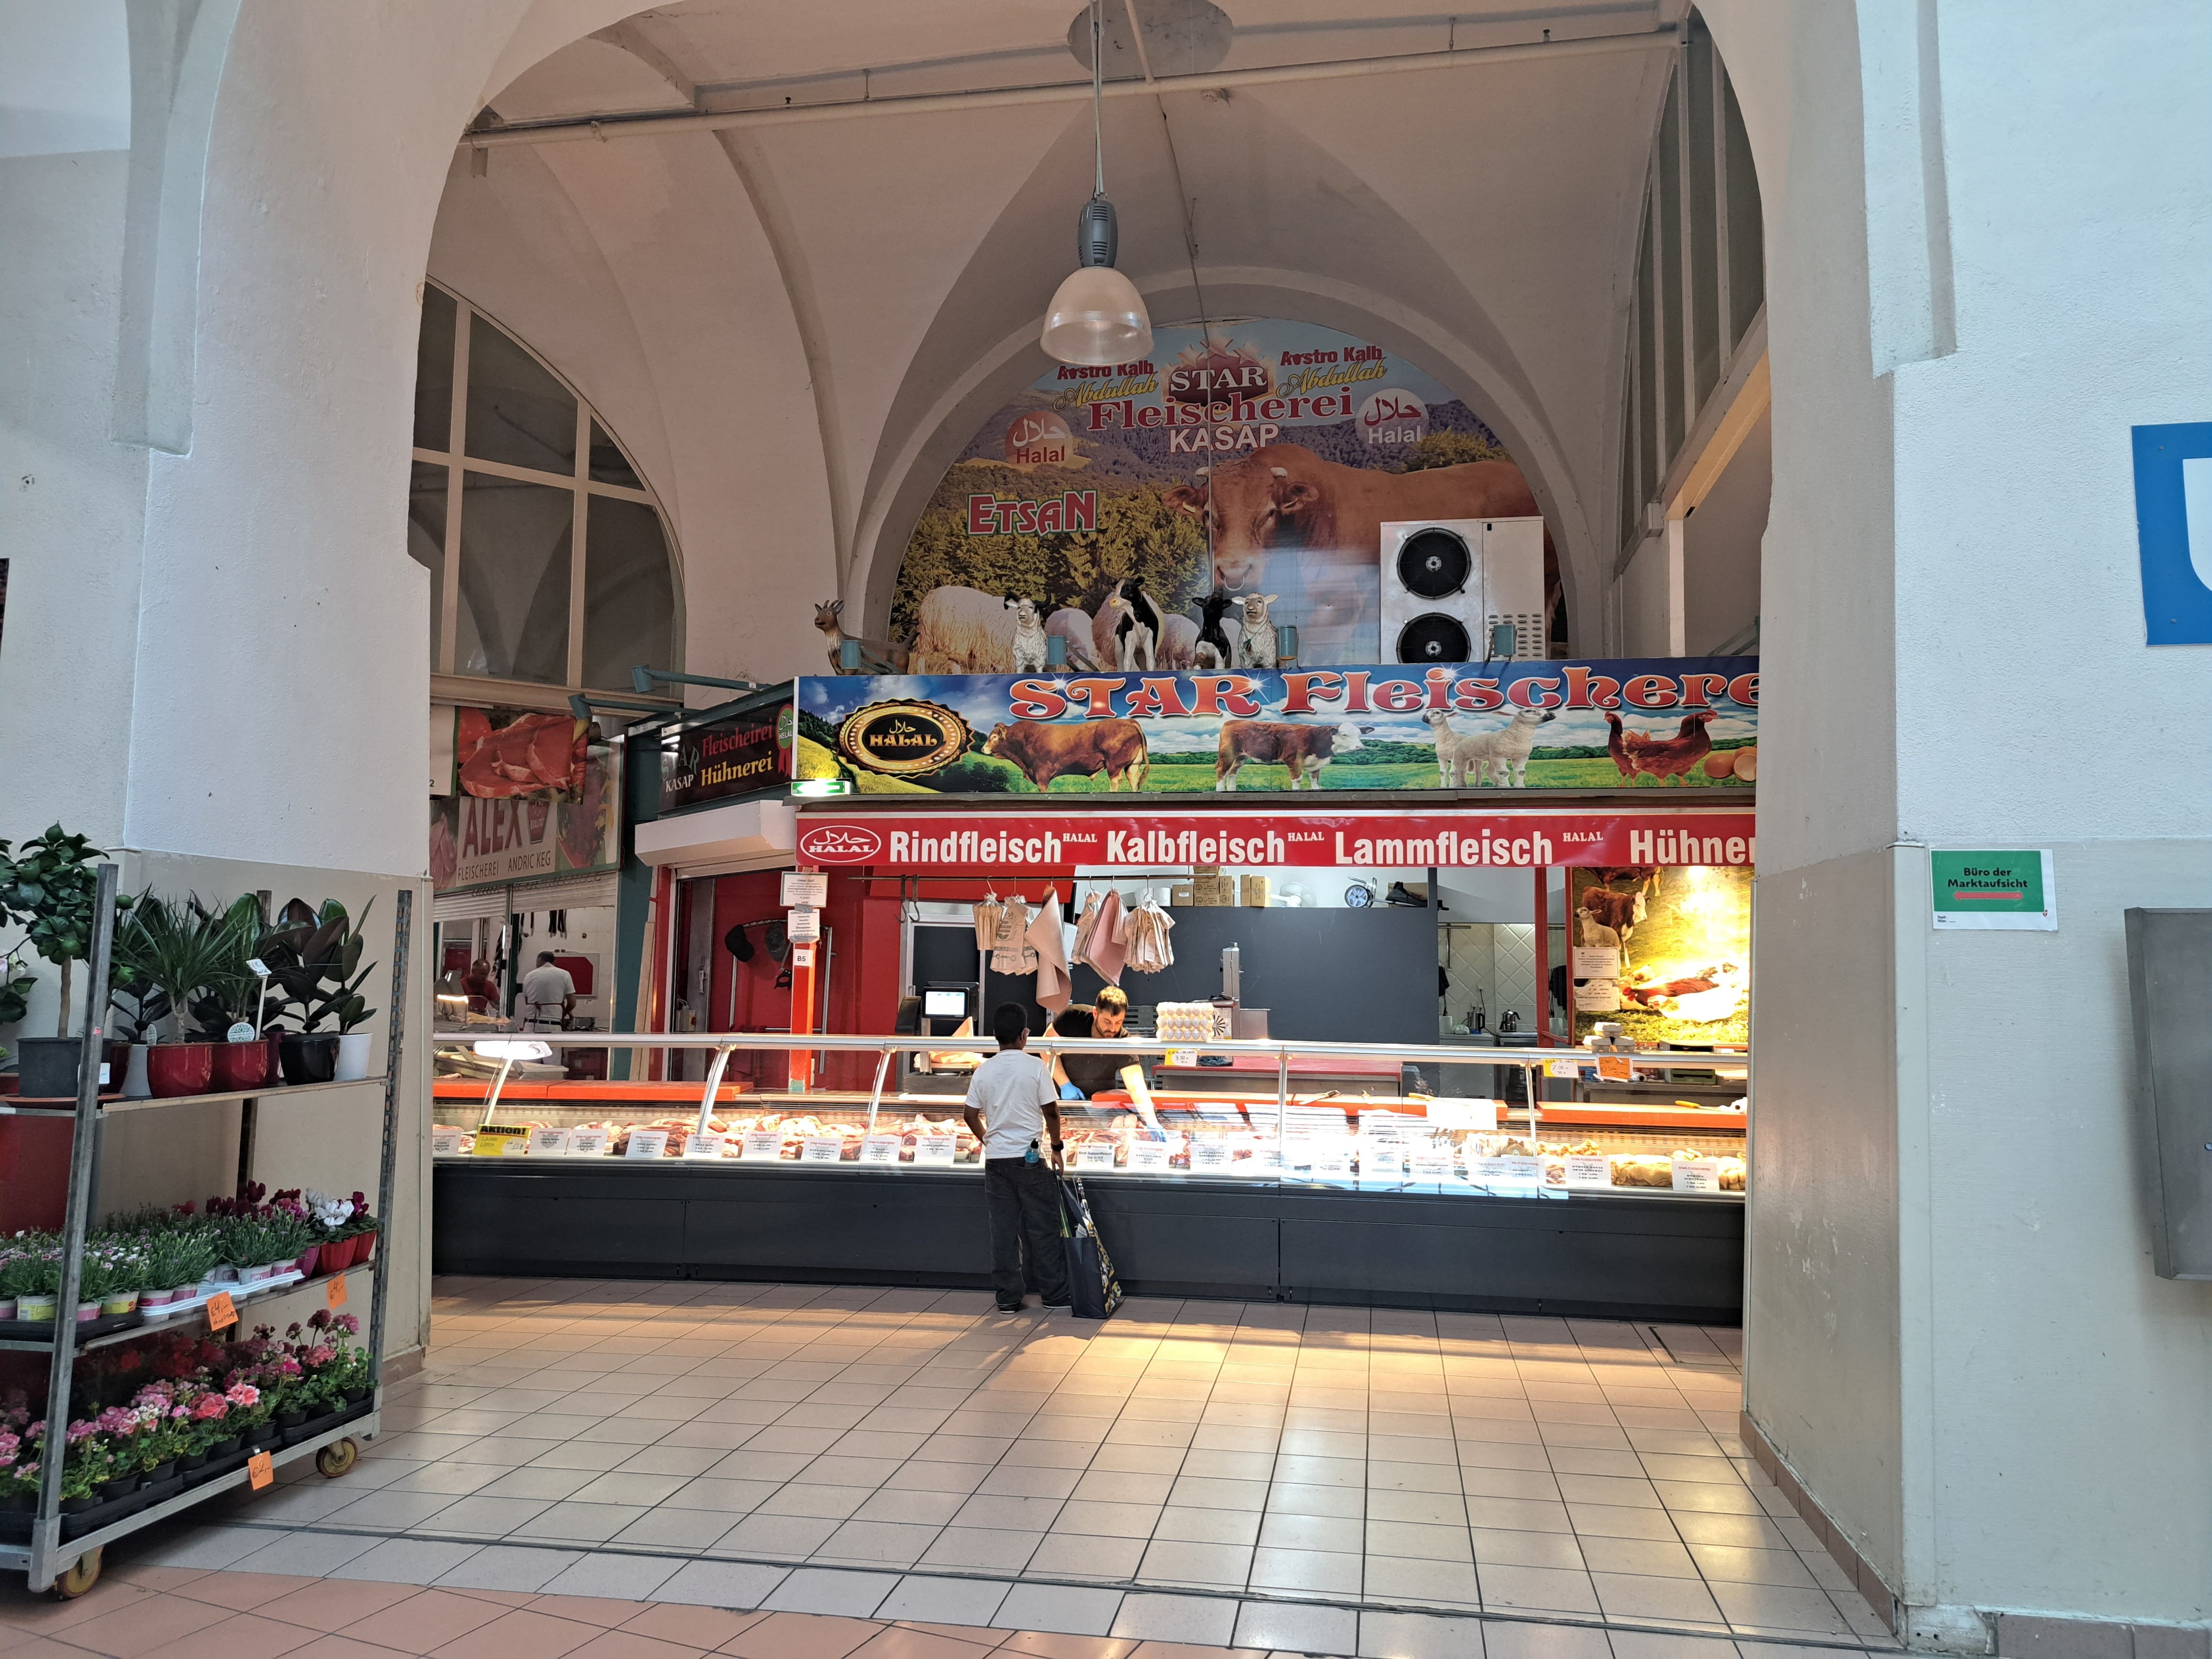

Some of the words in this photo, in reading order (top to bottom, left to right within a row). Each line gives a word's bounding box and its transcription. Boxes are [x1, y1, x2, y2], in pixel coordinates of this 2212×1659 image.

[1344, 345, 1382, 362] Kalb
[1117, 360, 1154, 376] Kalb
[1171, 366, 1267, 392] STAR
[1276, 356, 1387, 398] Abdullah
[1053, 371, 1159, 411] Abdullah
[1087, 386, 1354, 431] Fleischerei
[1364, 397, 1421, 426] حلال
[1012, 418, 1065, 447] حلال
[1170, 423, 1279, 453] KASAP
[1368, 426, 1421, 444] Halal
[1017, 446, 1064, 464] Halal
[1010, 674, 1260, 720] STAR
[779, 730, 793, 740] HELAL
[889, 719, 916, 734] حلال
[869, 734, 937, 747] HALAL
[701, 750, 774, 787] Hühnerei
[665, 774, 694, 793] KASAP
[463, 797, 522, 859] ALEX
[813, 830, 872, 845] حلال
[890, 830, 1061, 863] Rindfleisch
[1062, 833, 1097, 843] HALAL
[1107, 830, 1285, 863] Kalbfleisch
[1288, 831, 1325, 842] HALAL
[1335, 829, 1552, 864] Lammfleisch
[1563, 831, 1603, 842] HALAL
[458, 862, 499, 881] FLEISCHEREI
[508, 853, 534, 873] ANDRIC
[536, 851, 551, 867] KEG
[1964, 867, 1990, 876] Büro
[1993, 867, 2012, 876] der
[1947, 879, 2028, 887] Marktaufsicht
